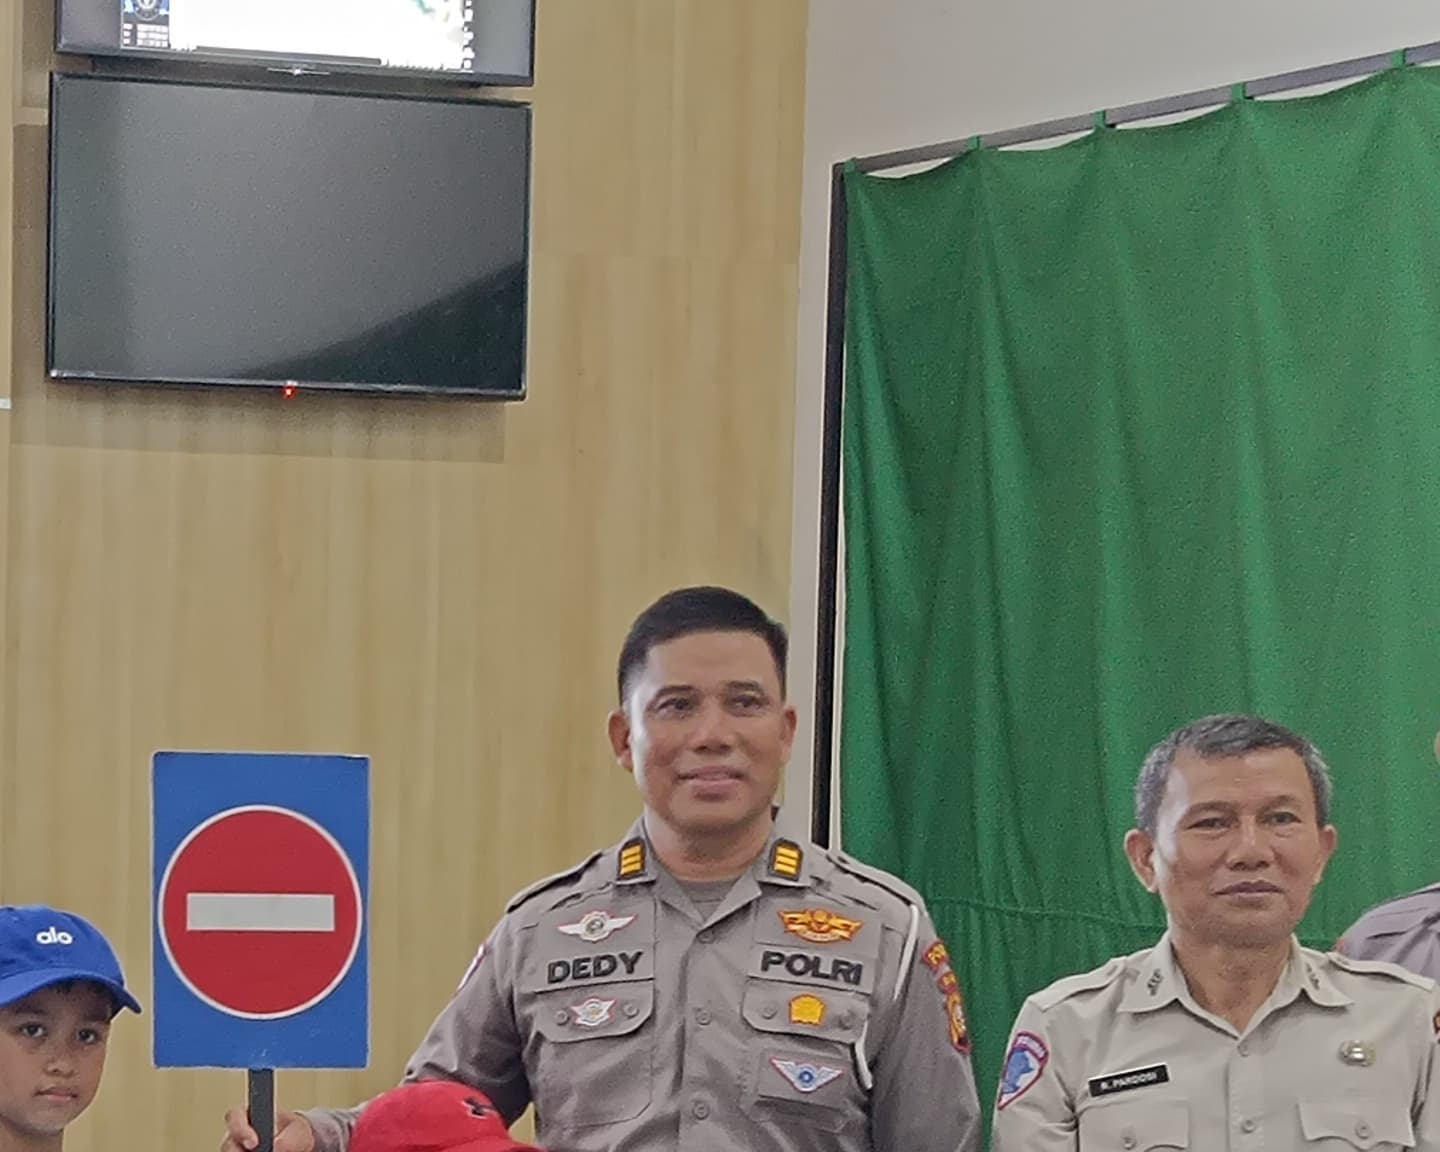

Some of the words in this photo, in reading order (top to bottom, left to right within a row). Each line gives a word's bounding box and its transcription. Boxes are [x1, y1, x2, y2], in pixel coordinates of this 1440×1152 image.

[36, 926, 73, 944] alo
[548, 951, 644, 984] DEDY
[760, 950, 864, 986] POLRI
